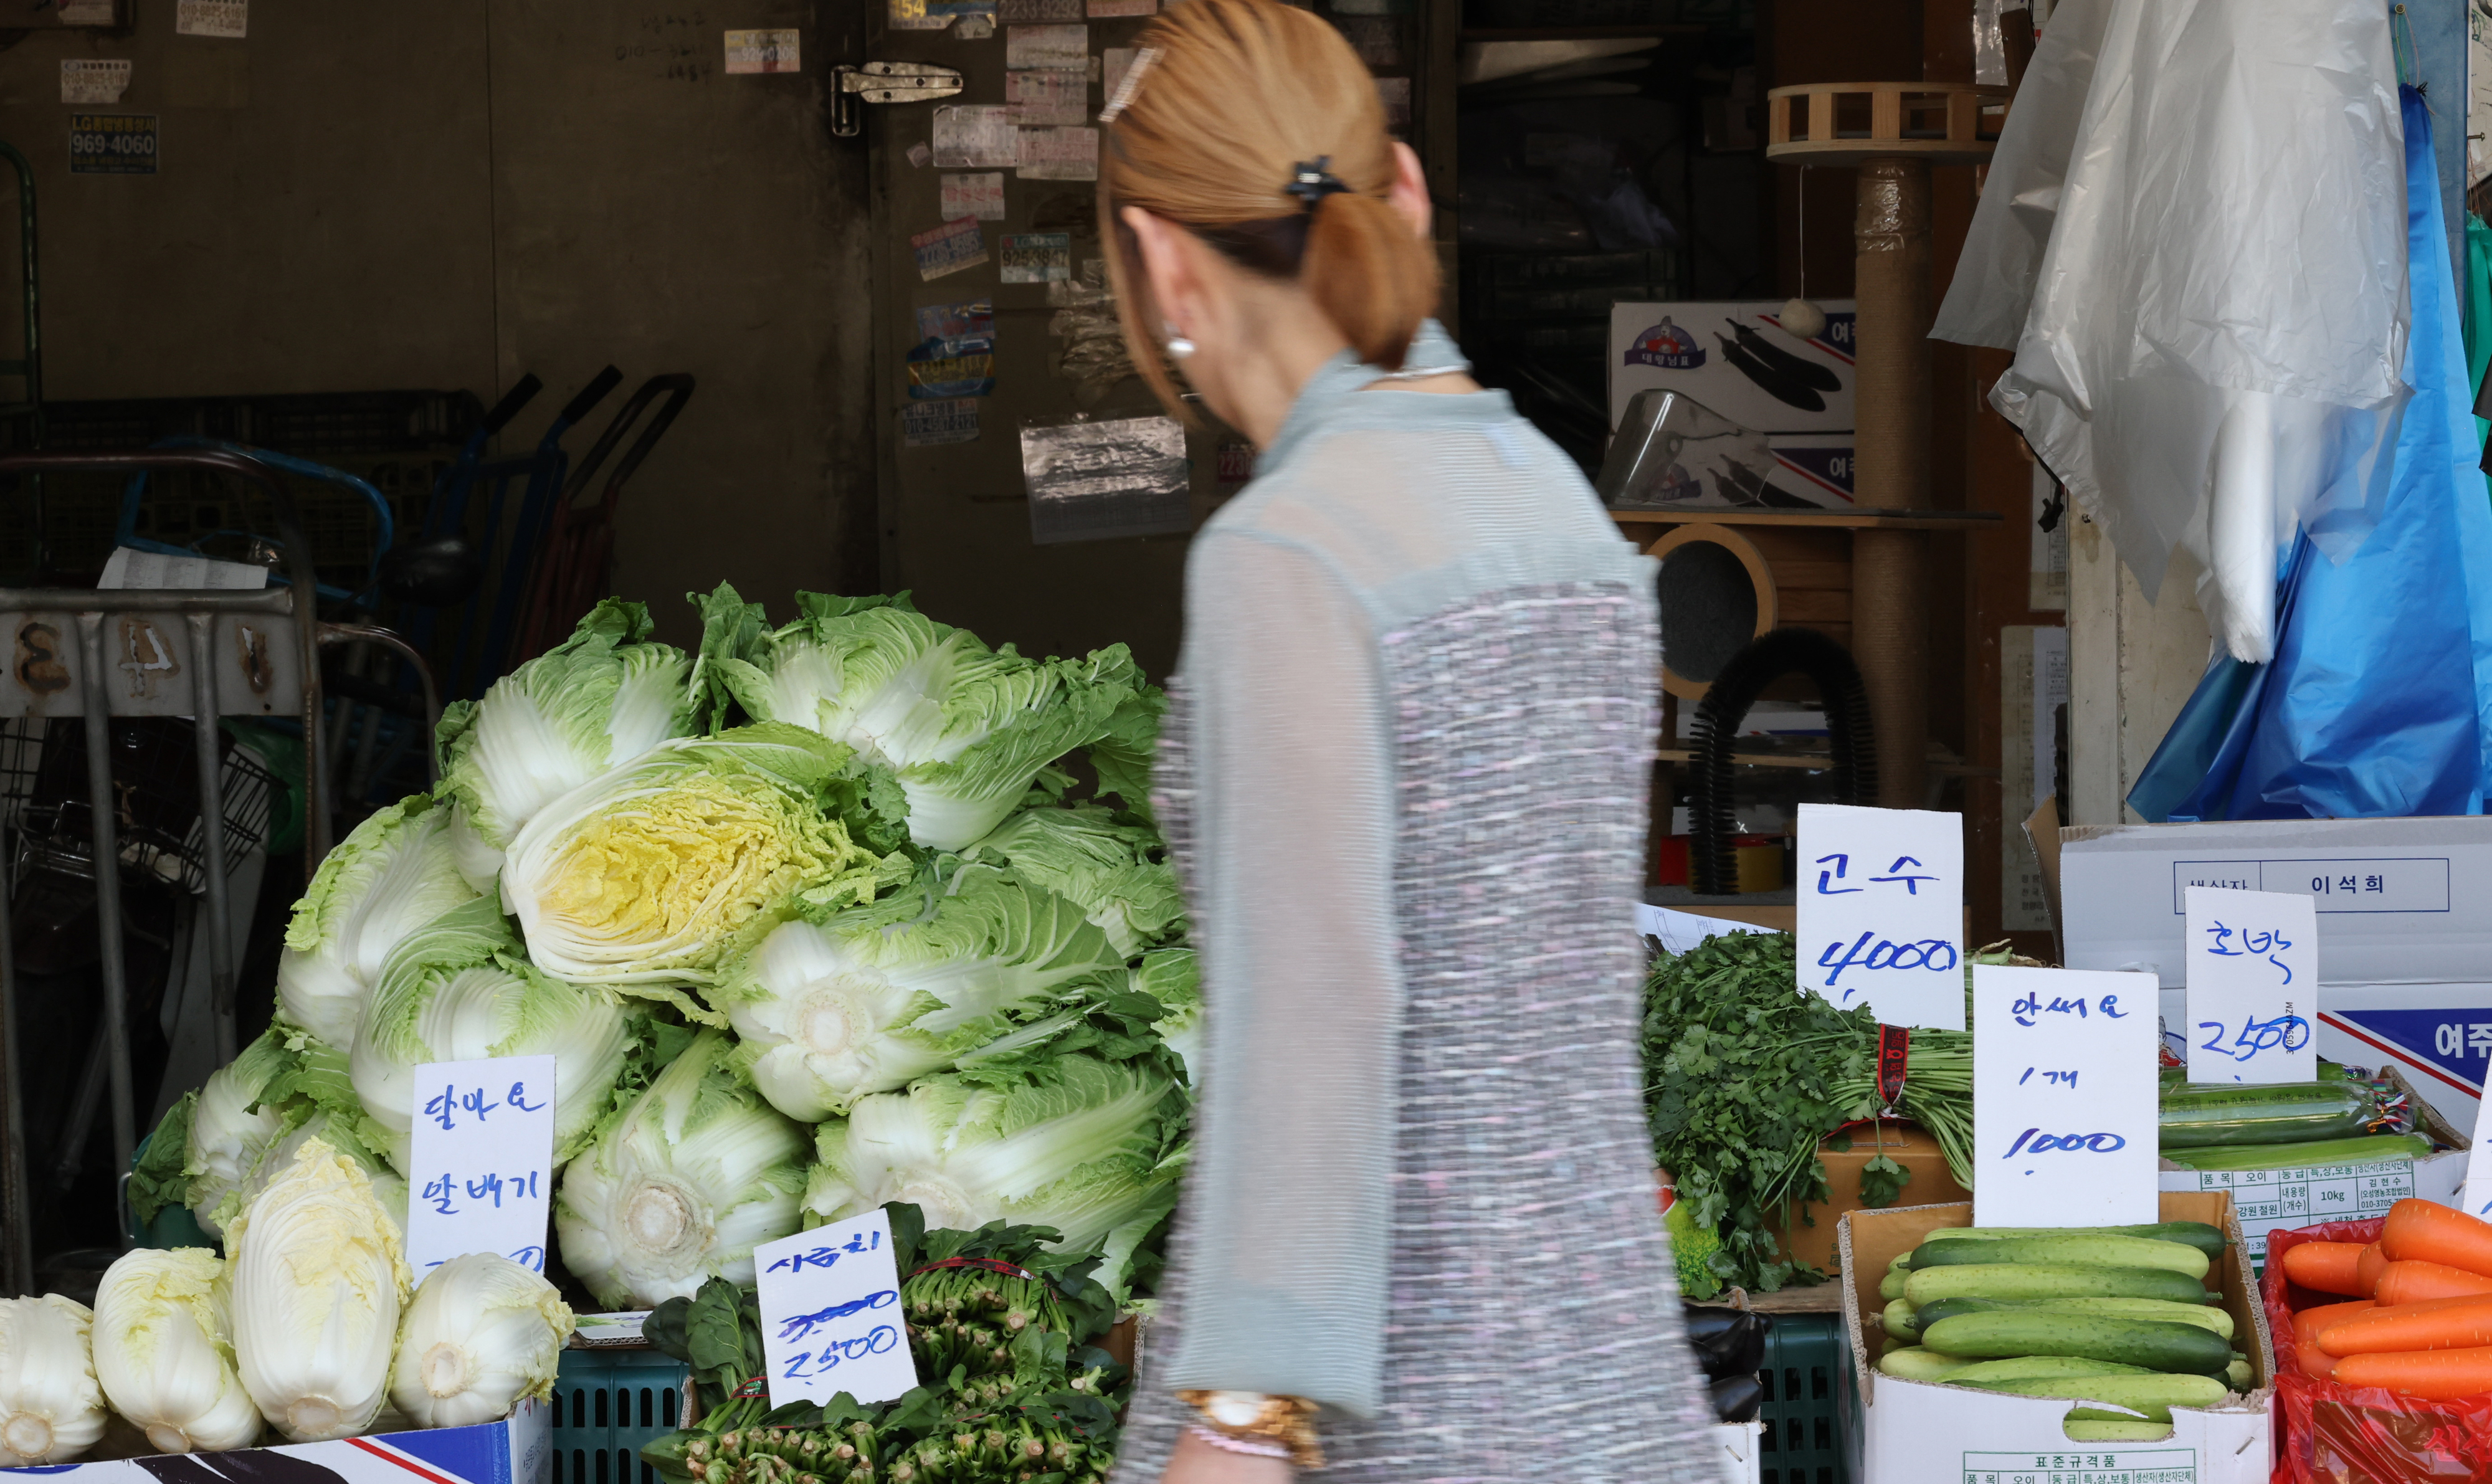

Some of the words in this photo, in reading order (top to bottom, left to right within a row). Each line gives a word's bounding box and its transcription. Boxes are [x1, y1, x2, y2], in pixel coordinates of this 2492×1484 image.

[72, 135, 154, 154] 969-4060
[1641, 353, 1689, 367] 대왕님표
[1817, 854, 1941, 895] 고수
[2311, 875, 2384, 894] 이석희
[2206, 920, 2293, 985] 호박
[2019, 1066, 2078, 1089] 1개
[2246, 1171, 2266, 1182] 오이
[422, 1171, 538, 1215] 알배기
[2282, 1187, 2306, 1197] 내용량
[2321, 1191, 2344, 1201] 10kg
[2369, 1177, 2401, 1187] 김현수
[2238, 1206, 2257, 1217] 강원
[2258, 1204, 2277, 1215] 철원
[2283, 1199, 2306, 1212] (개수)
[2035, 1455, 2116, 1468] 표준규격품
[2014, 1475, 2035, 1484] 오이
[2135, 1470, 2194, 1483] 생산자(생산자단체)
